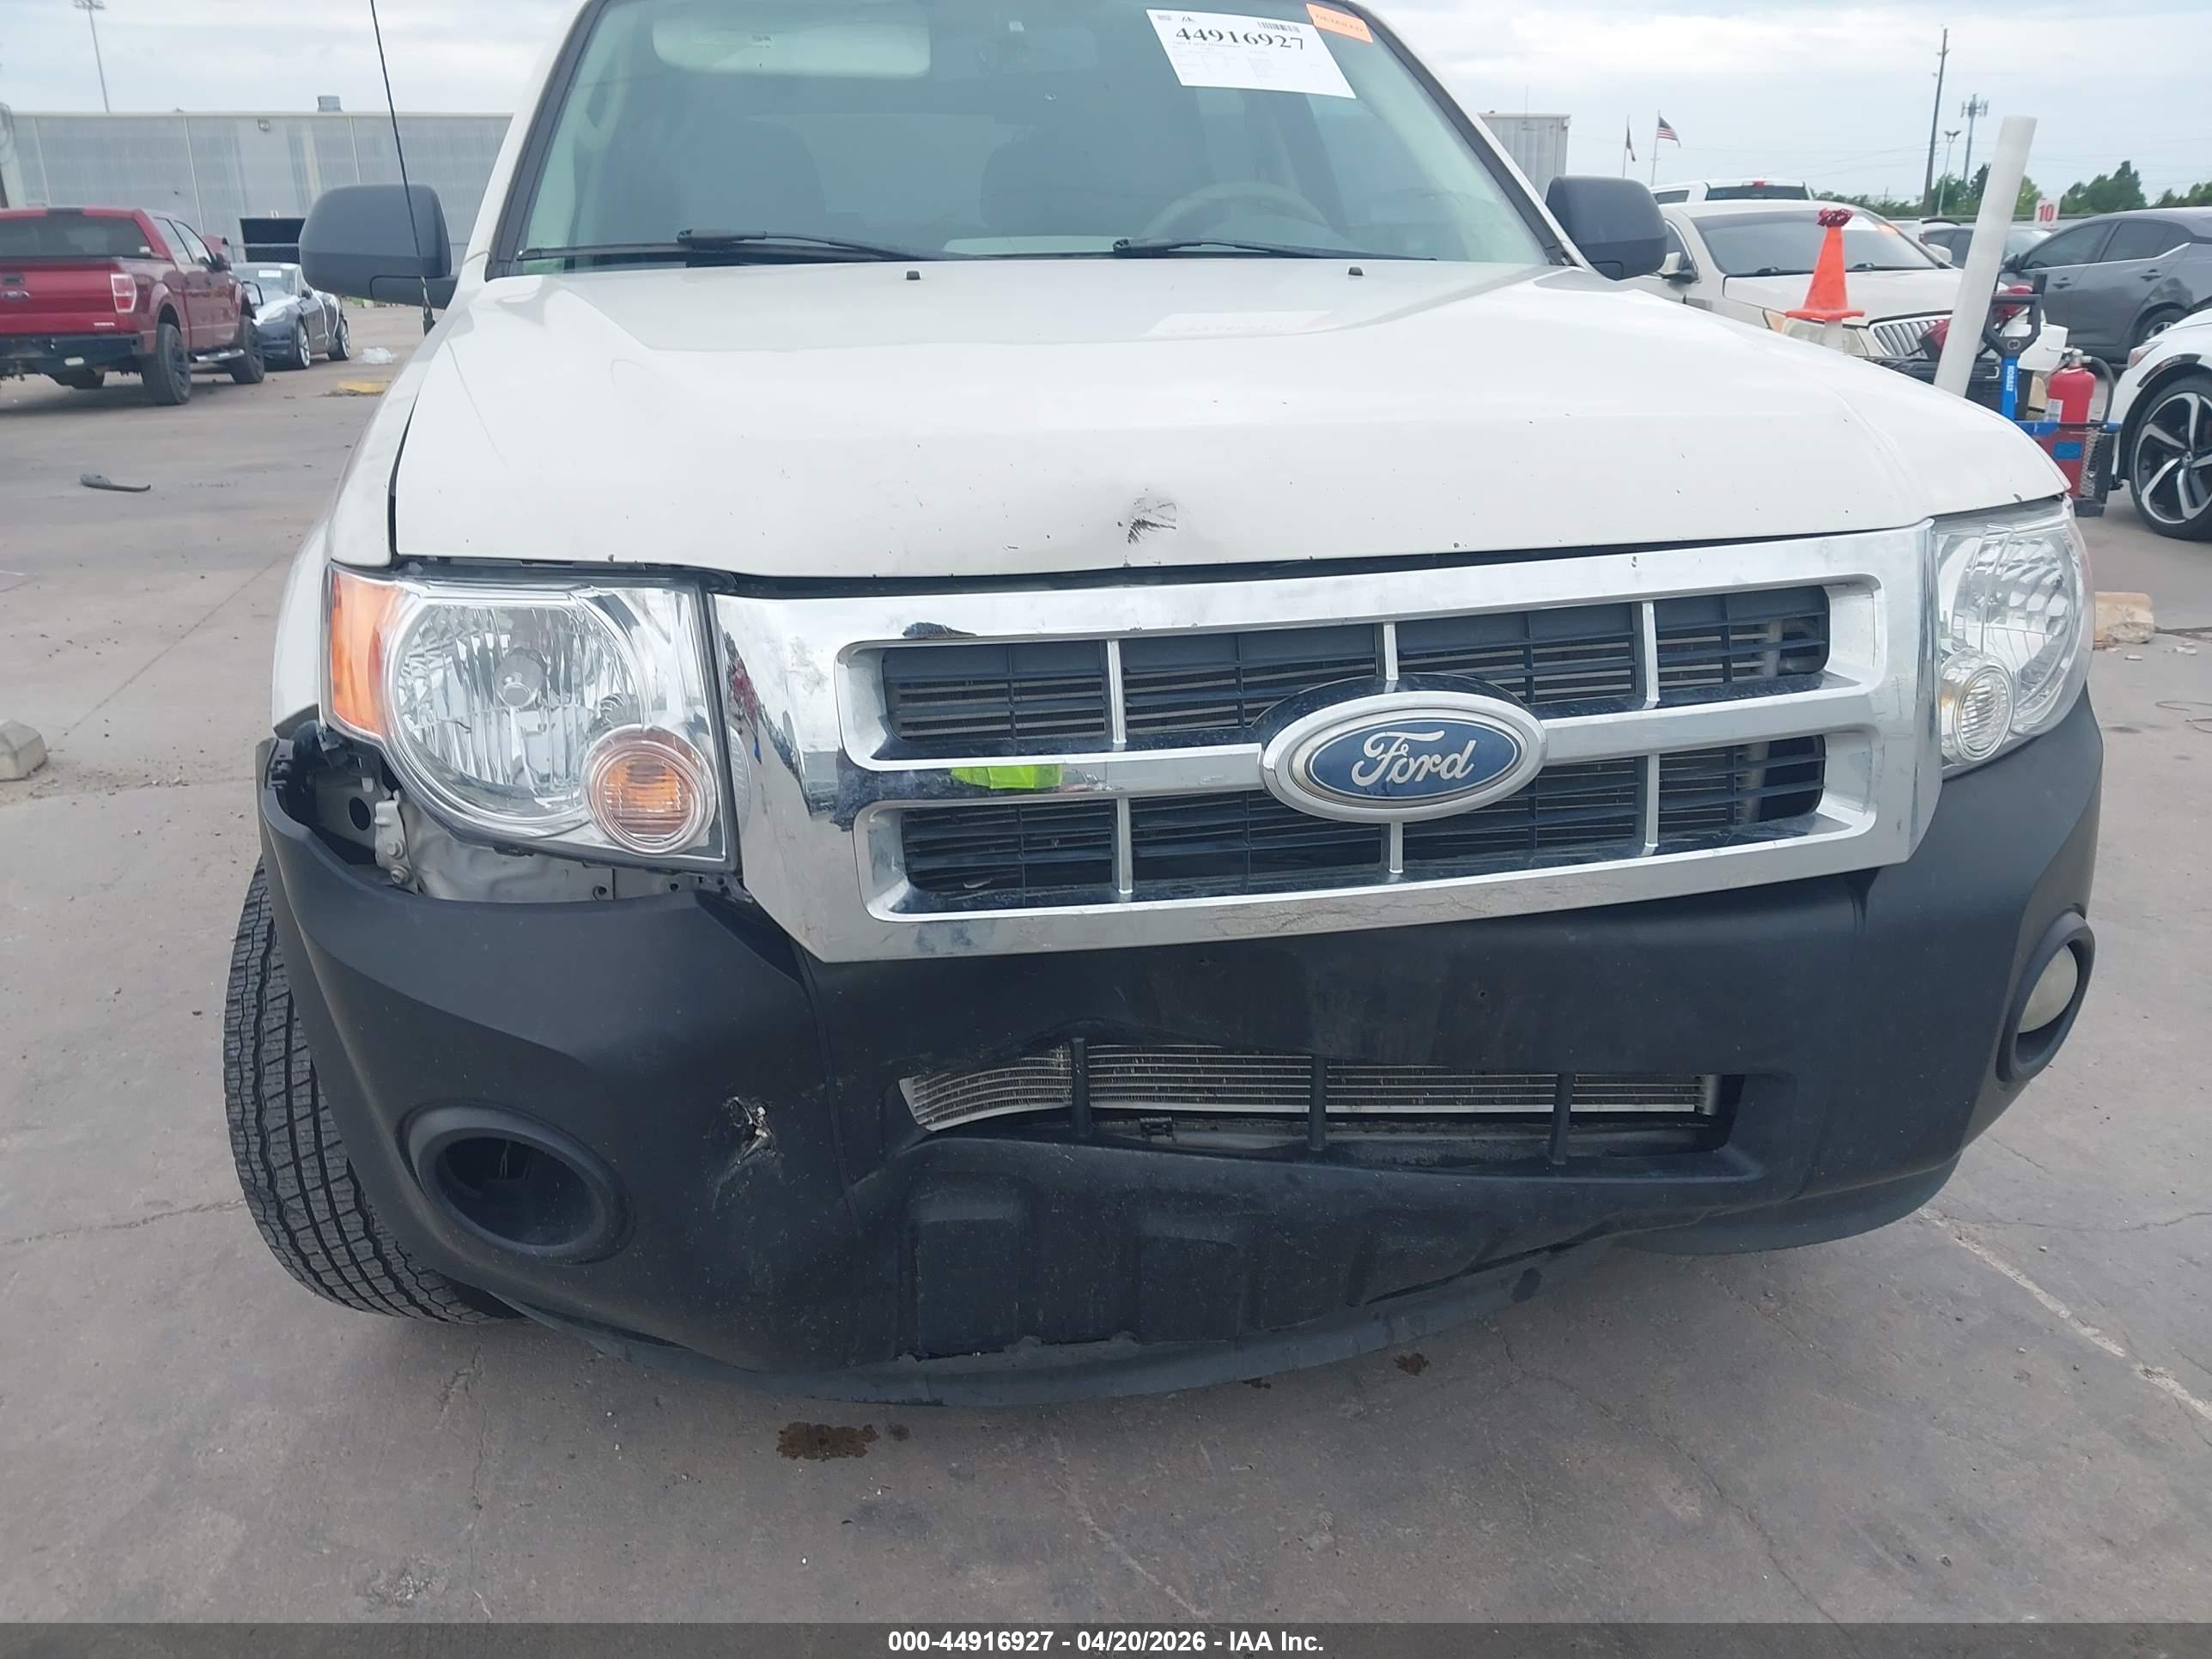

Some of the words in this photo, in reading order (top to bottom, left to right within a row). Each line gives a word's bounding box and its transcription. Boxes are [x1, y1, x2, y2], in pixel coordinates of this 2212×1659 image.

[1176, 27, 1304, 50] 44916927
[2039, 203, 2055, 222] 10
[1351, 729, 1477, 787] Ford
